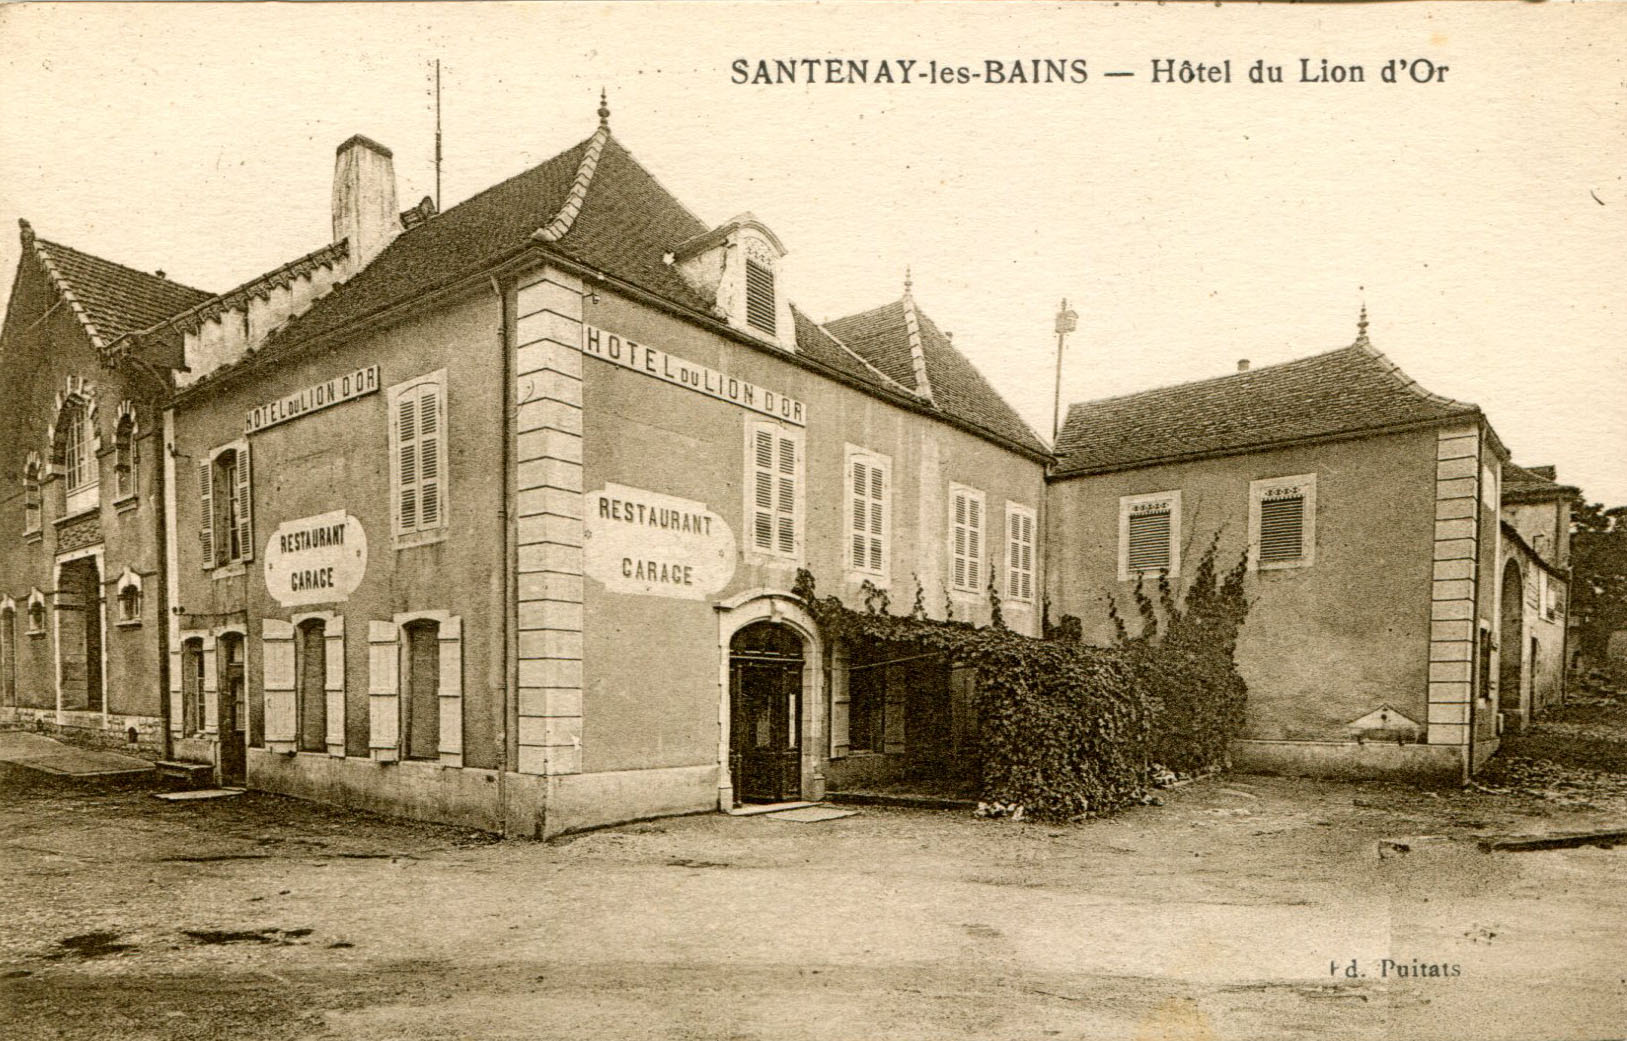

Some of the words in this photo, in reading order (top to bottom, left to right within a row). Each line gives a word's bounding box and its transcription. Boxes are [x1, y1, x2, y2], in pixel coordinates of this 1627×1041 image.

[588, 327, 674, 378] HOTEL
[680, 368, 699, 386] DU
[704, 369, 753, 405] LION
[245, 402, 286, 431] HOTEL
[288, 401, 299, 416] DU
[302, 381, 335, 411] LION
[599, 497, 712, 536] RESTAURANT
[280, 523, 345, 554] RESTAURANT
[291, 567, 334, 592] GARAGE
[622, 557, 693, 586] GARAGE
